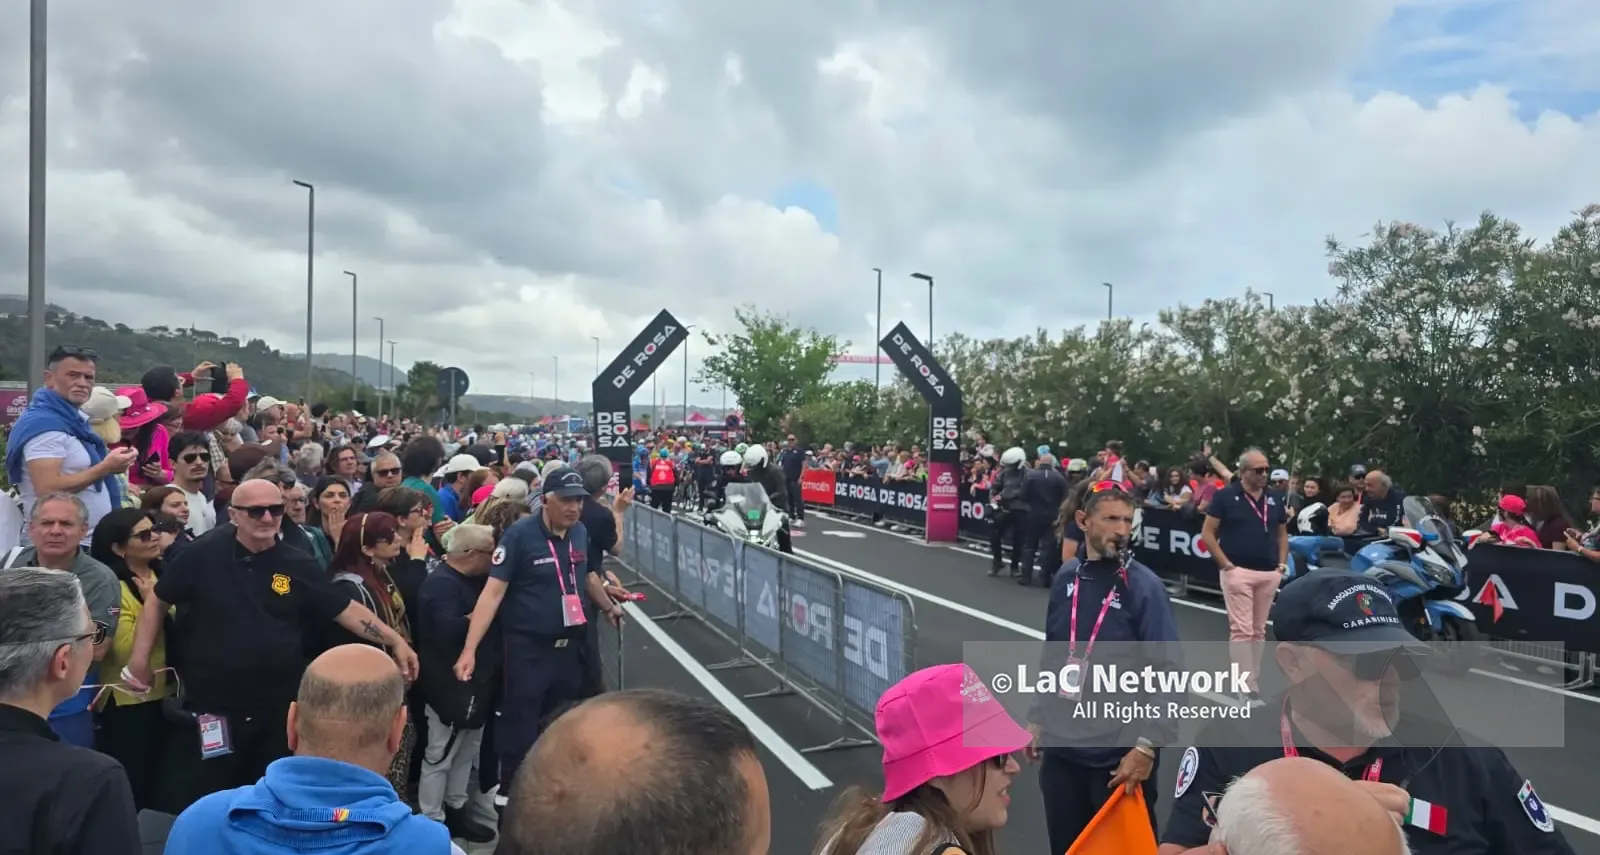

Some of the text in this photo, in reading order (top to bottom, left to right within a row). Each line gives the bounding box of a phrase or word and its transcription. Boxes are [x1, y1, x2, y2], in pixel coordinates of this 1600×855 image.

[612, 325, 677, 389] DE ROSA
[892, 333, 945, 398] DE ROSA
[597, 411, 627, 424] DE
[932, 417, 958, 429] DE
[597, 424, 629, 436] RO
[932, 429, 959, 441] RO
[598, 436, 630, 448] SA
[933, 440, 959, 450] SA
[835, 482, 848, 496] DE
[849, 485, 877, 502] ROSA
[880, 488, 896, 505] DE
[961, 501, 985, 520] RO
[1170, 529, 1212, 559] RO
